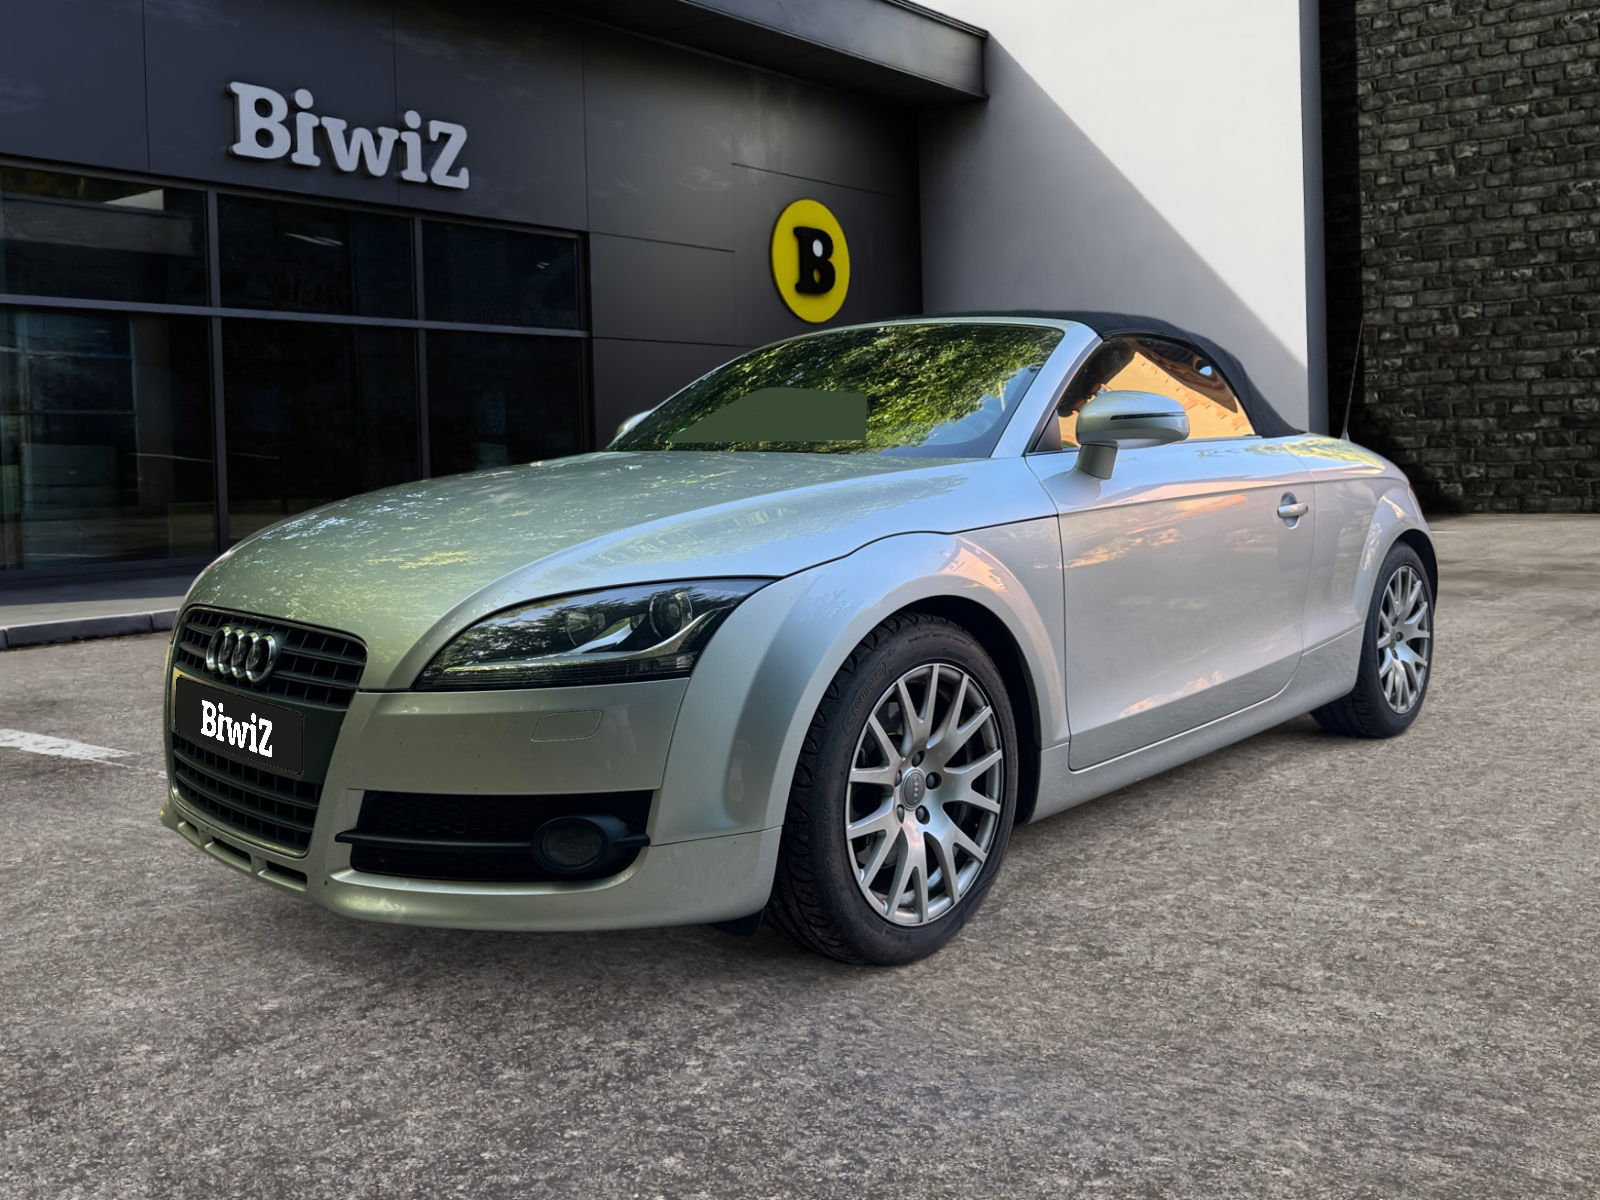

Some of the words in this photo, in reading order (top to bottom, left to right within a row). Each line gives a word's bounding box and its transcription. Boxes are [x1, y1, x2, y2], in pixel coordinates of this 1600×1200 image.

[227, 81, 469, 189] BiwiZ
[793, 226, 836, 295] B
[201, 700, 273, 758] BiwiZ
